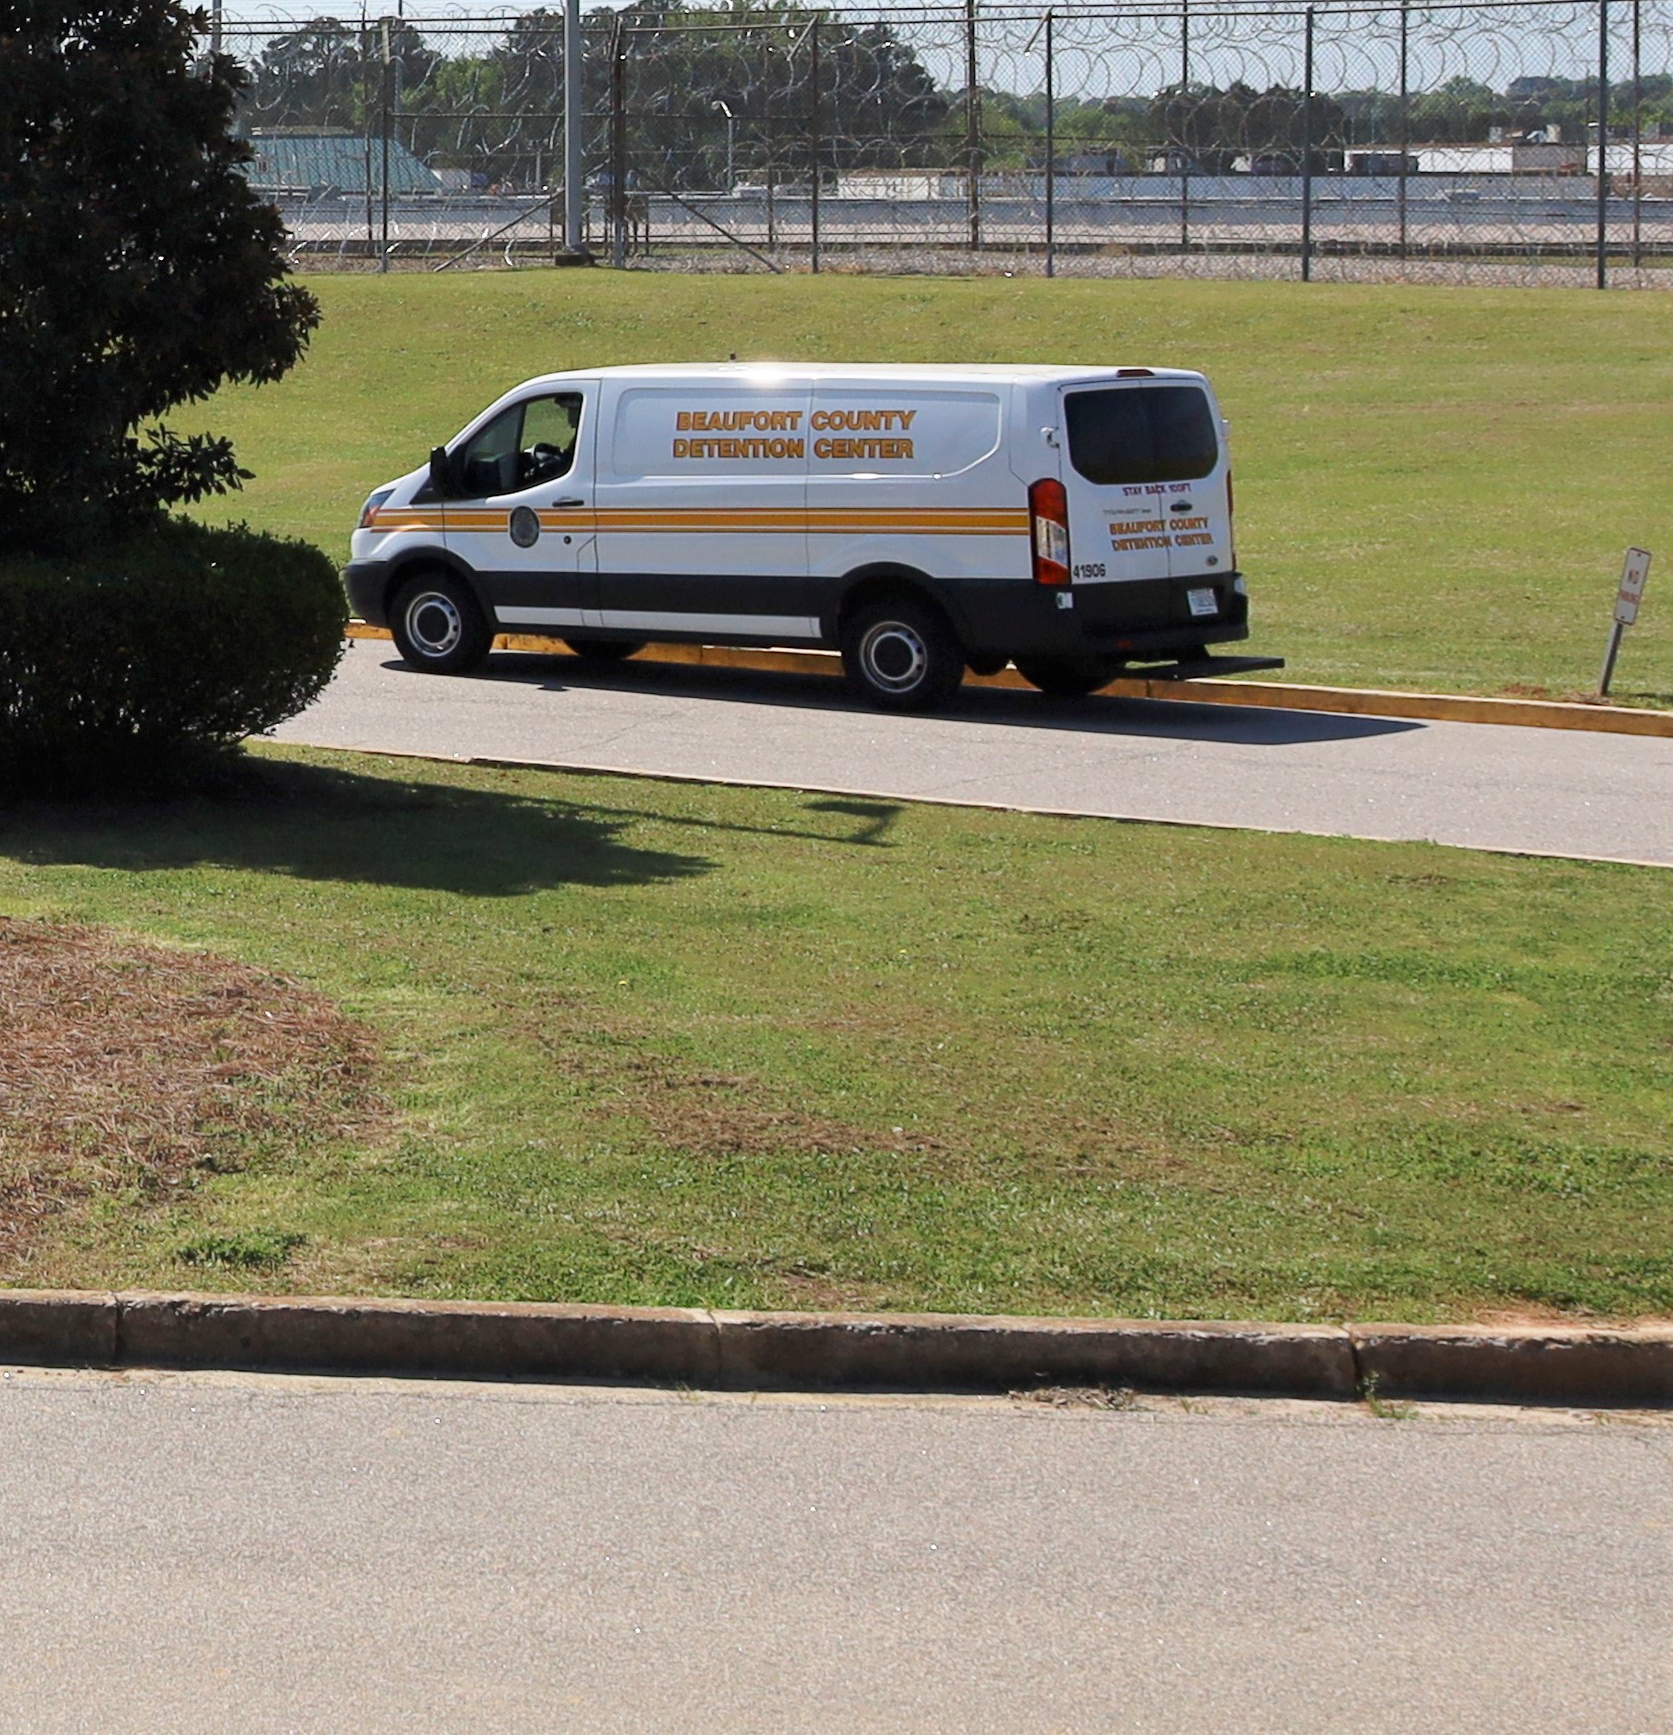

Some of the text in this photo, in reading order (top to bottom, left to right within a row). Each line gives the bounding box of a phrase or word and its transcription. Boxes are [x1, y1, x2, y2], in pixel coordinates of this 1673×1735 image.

[676, 410, 917, 431] BEAUFORT COUNTY
[673, 438, 914, 459] DETENTION CENTER
[1122, 485, 1142, 496] STAY
[1145, 484, 1166, 495] BACK
[1110, 516, 1208, 535] BEAUFORT COUNTY
[1112, 533, 1214, 551] DETENTION CENTER
[1073, 564, 1106, 579] 41906
